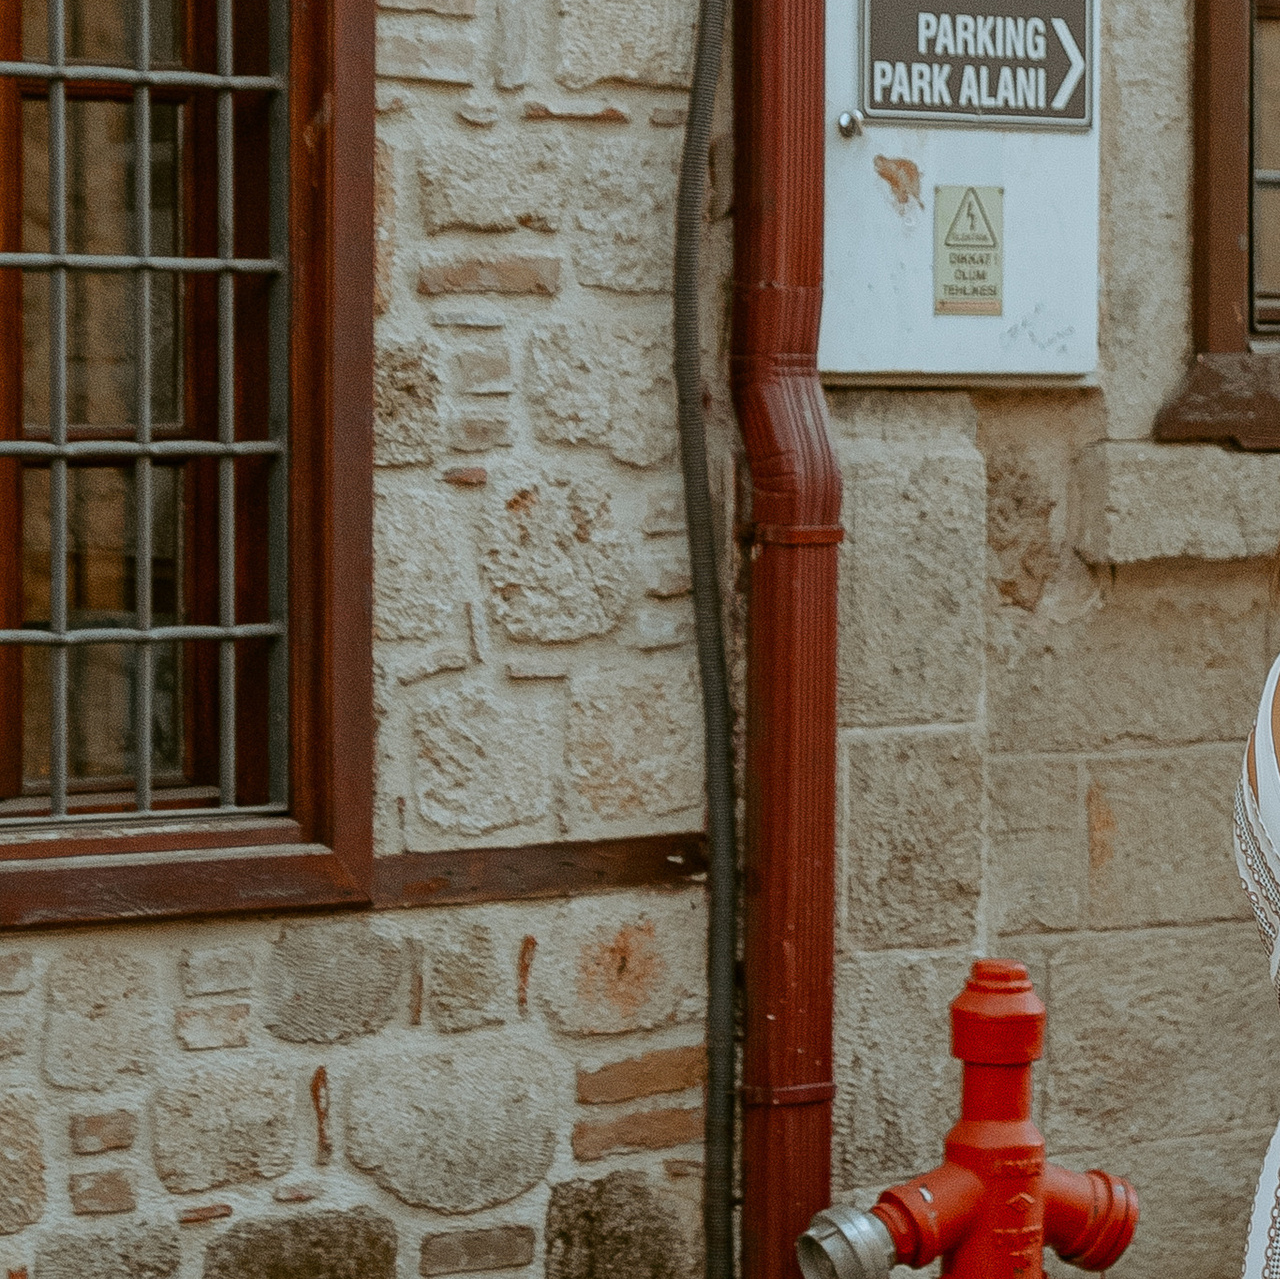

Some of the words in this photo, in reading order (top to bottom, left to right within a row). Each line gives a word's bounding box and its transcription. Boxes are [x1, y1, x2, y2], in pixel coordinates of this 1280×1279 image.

[917, 12, 1047, 61] PARKING
[873, 60, 952, 106] PARK
[959, 65, 1046, 110] ALANI
